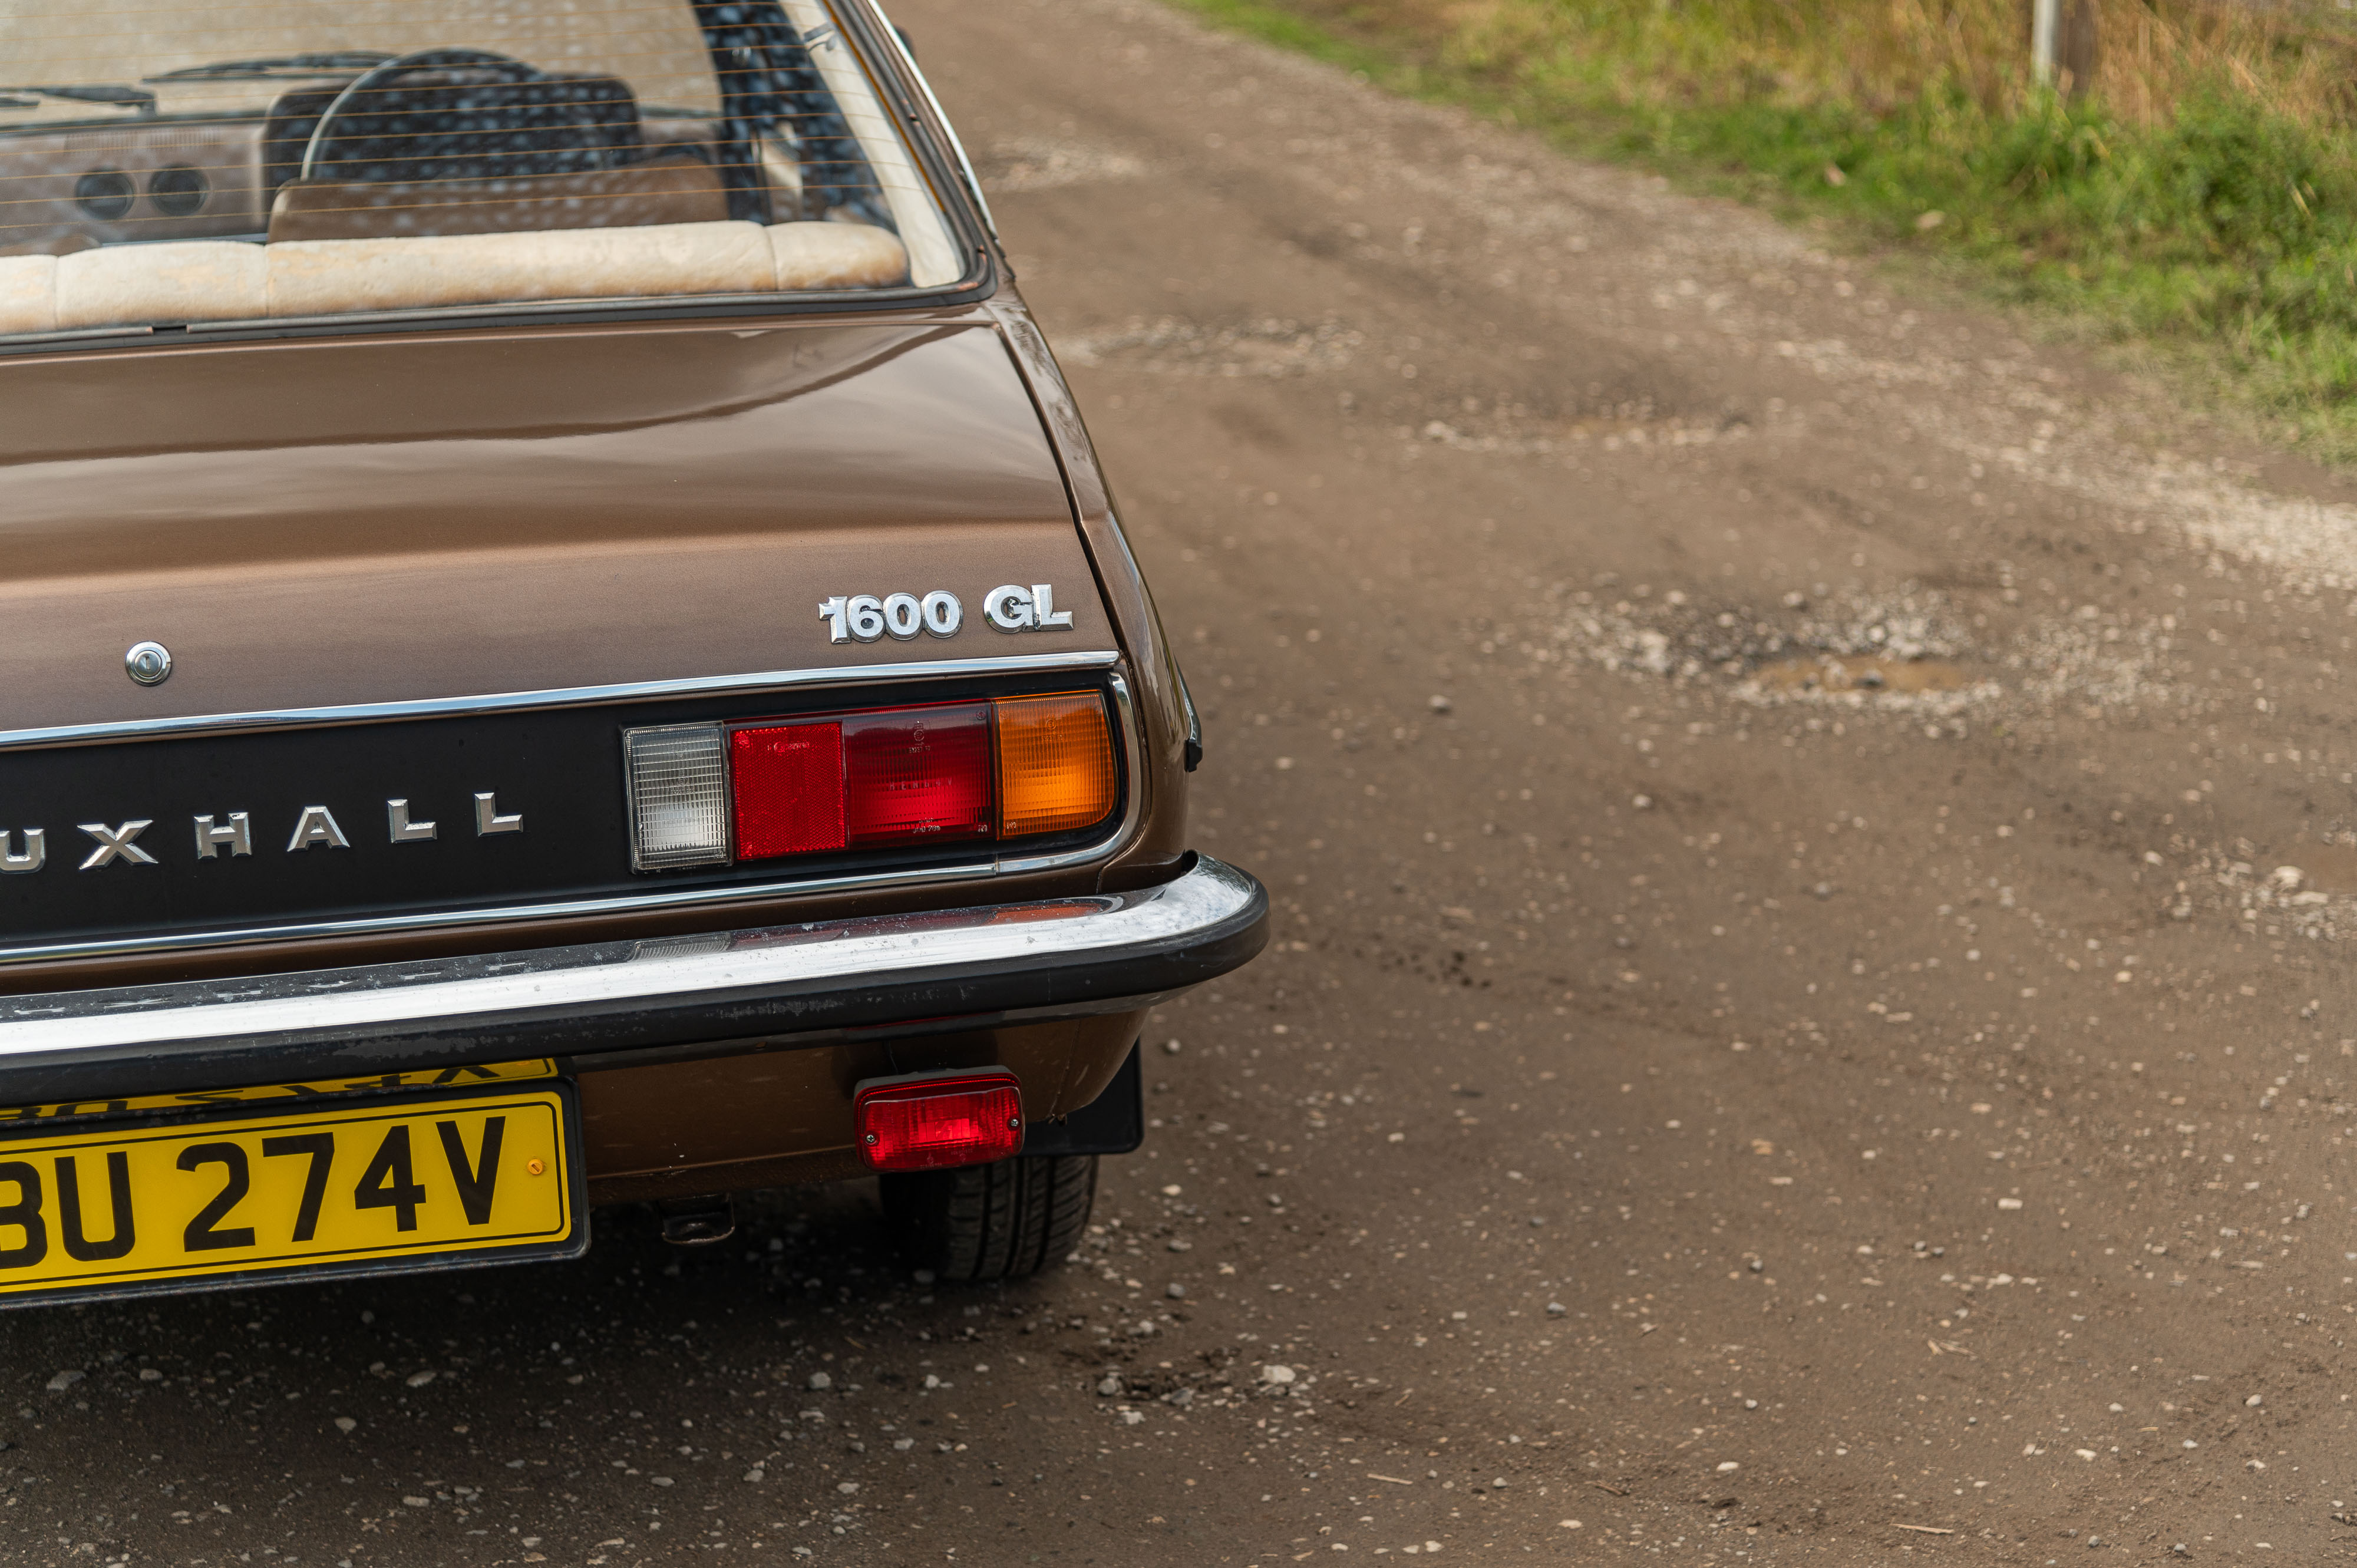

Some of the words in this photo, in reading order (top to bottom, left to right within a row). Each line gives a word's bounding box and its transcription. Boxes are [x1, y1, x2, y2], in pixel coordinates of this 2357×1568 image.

[818, 590, 963, 644] 1600
[983, 584, 1074, 634] GL
[0, 792, 524, 874] UXHALL
[176, 1116, 506, 1253] 274V
